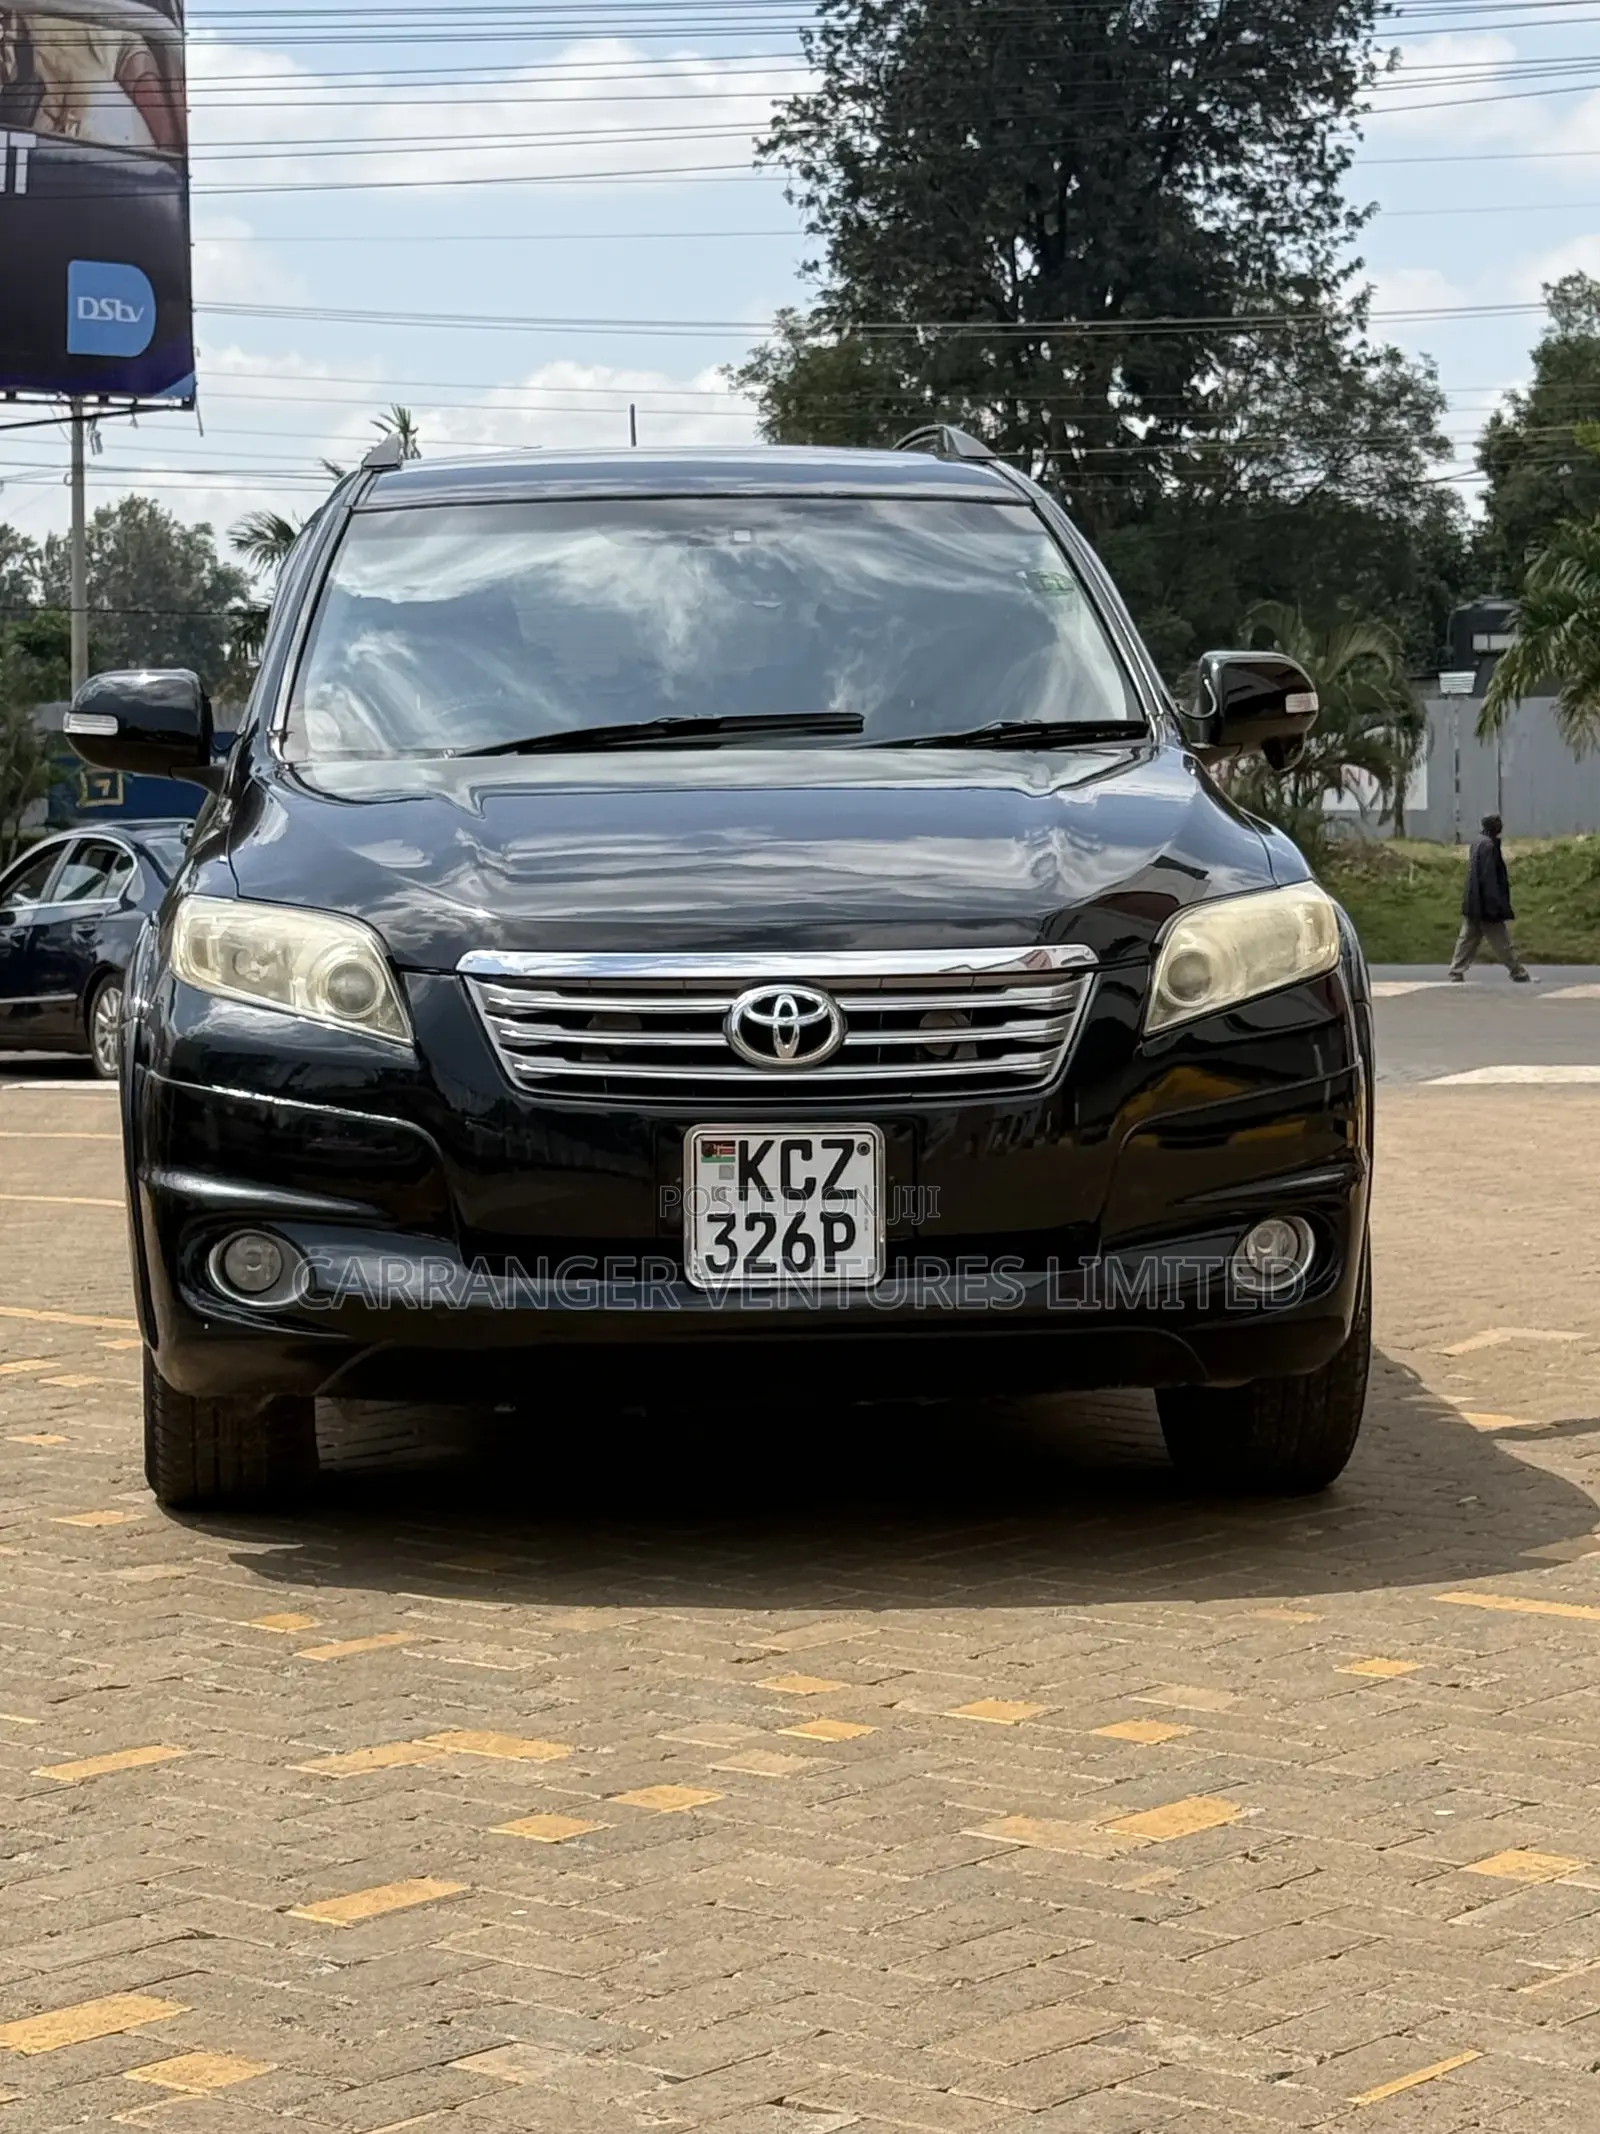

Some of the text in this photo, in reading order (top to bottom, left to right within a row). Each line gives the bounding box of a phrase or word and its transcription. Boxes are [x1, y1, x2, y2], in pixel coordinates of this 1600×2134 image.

[77, 296, 144, 323] DStv
[738, 1139, 857, 1202] KCZ
[705, 1211, 856, 1274] 326P
